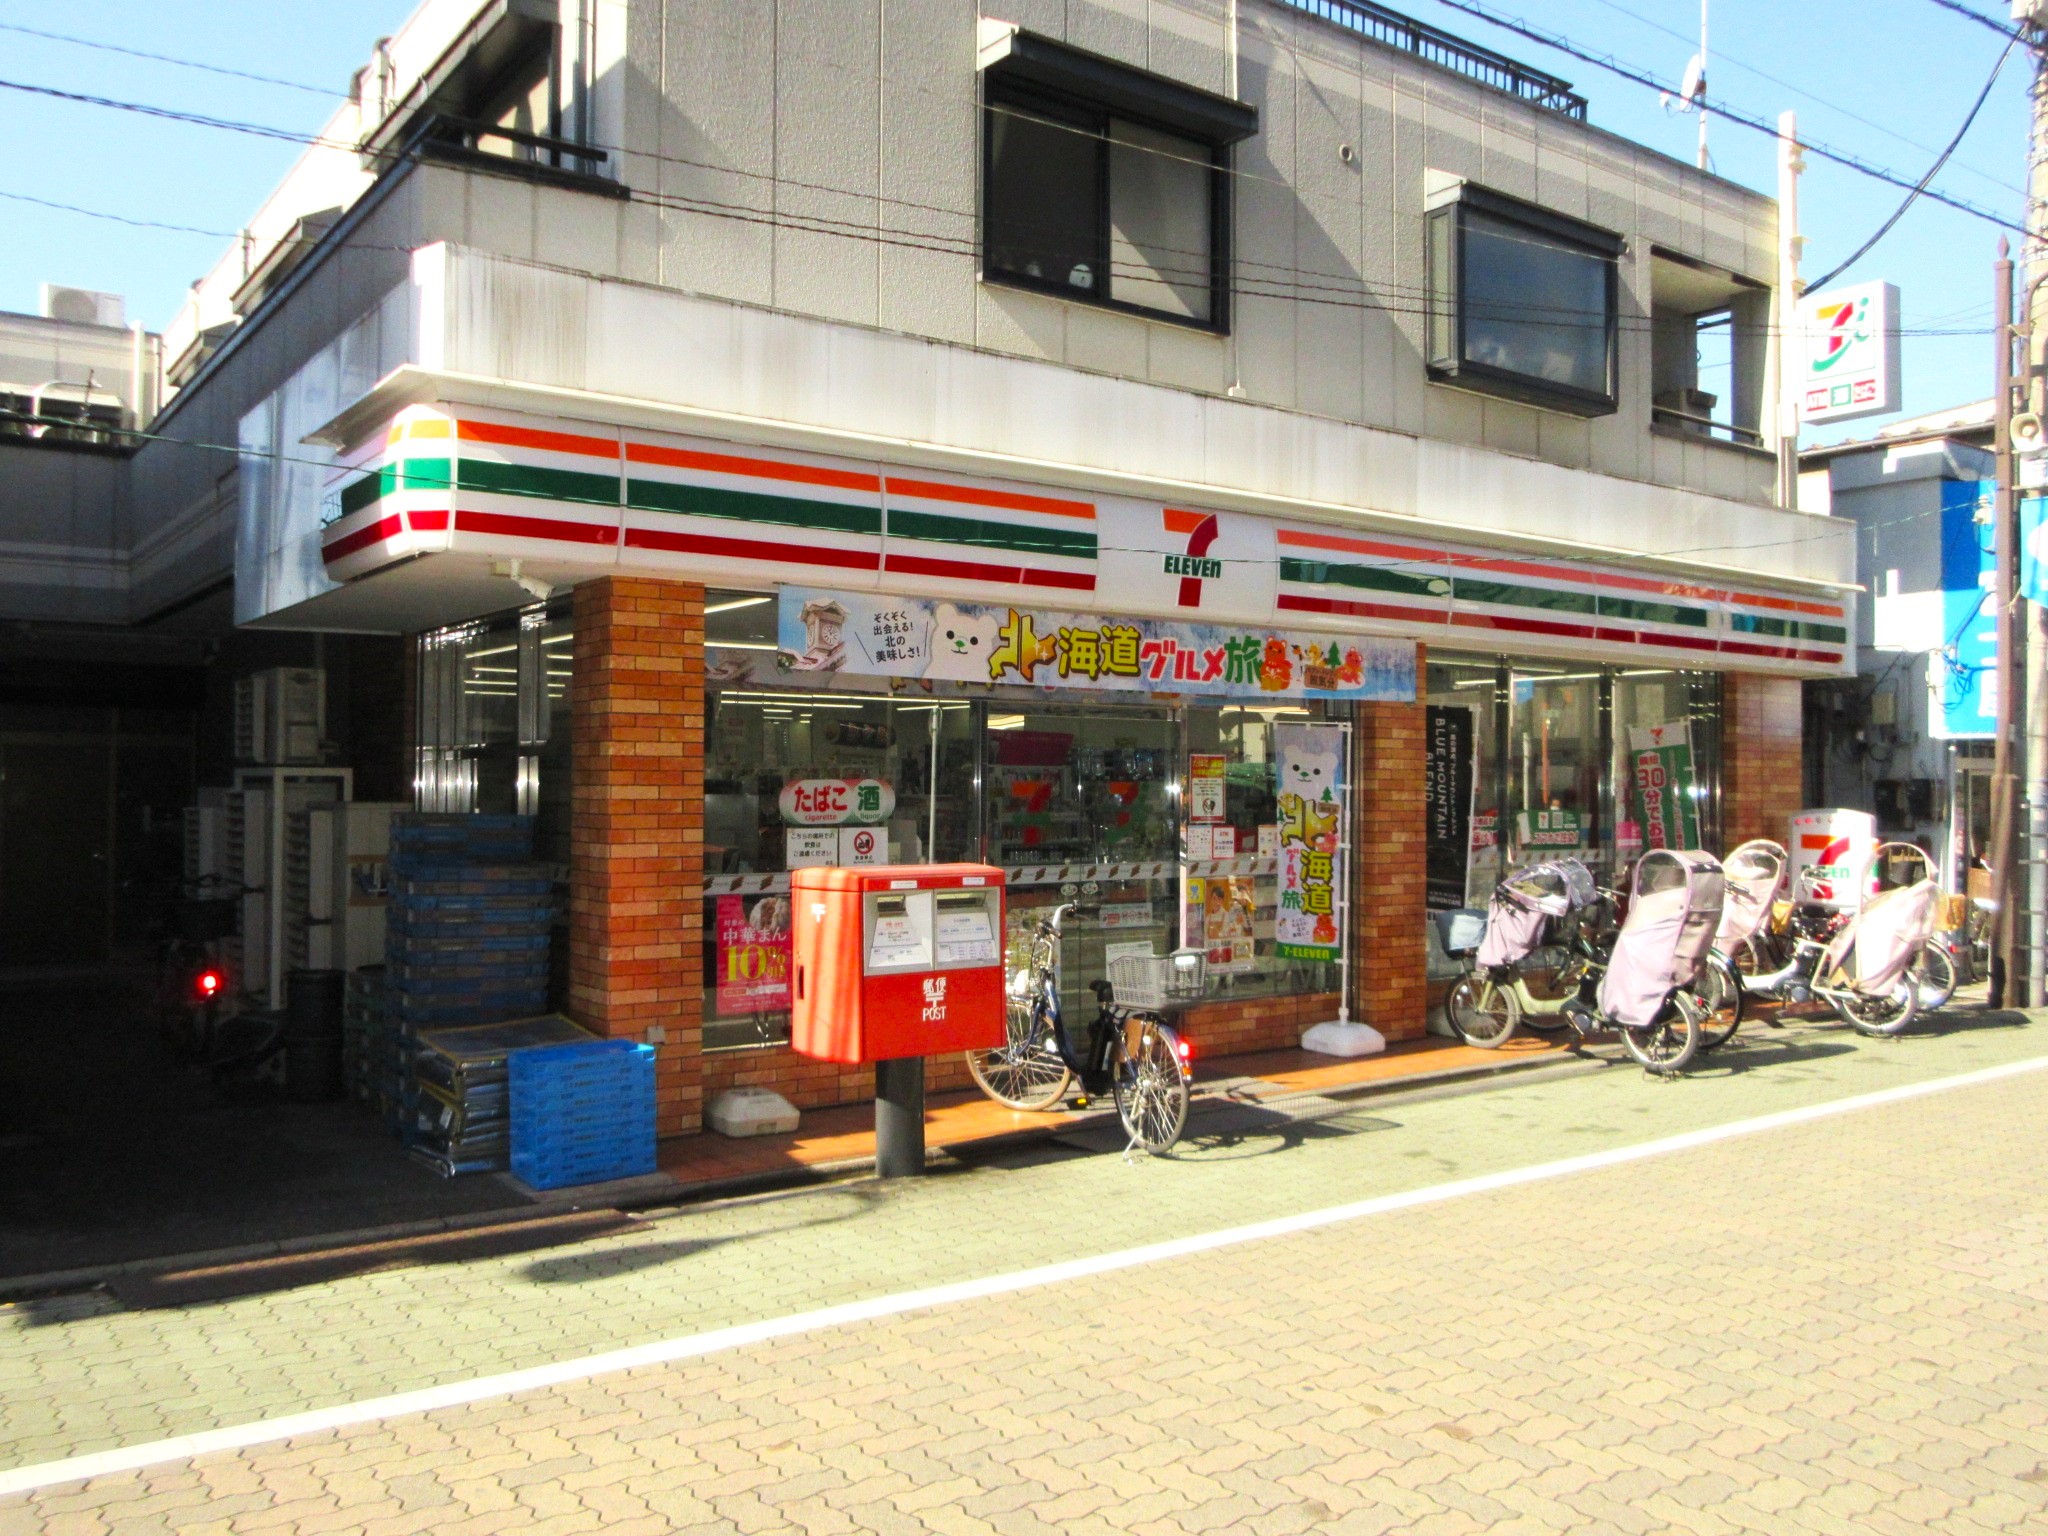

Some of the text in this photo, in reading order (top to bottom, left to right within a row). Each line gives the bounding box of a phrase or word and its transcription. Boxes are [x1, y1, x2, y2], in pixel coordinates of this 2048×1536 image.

[885, 635, 906, 648] 北の
[1435, 717, 1449, 839] BLUE MOUNTAIN
[794, 784, 848, 812] たばこ
[858, 785, 880, 811] 酒
[804, 813, 837, 822] cigarette
[723, 927, 787, 945] 中華まん
[923, 976, 946, 995] 郵便
[922, 1006, 946, 1022] POST
